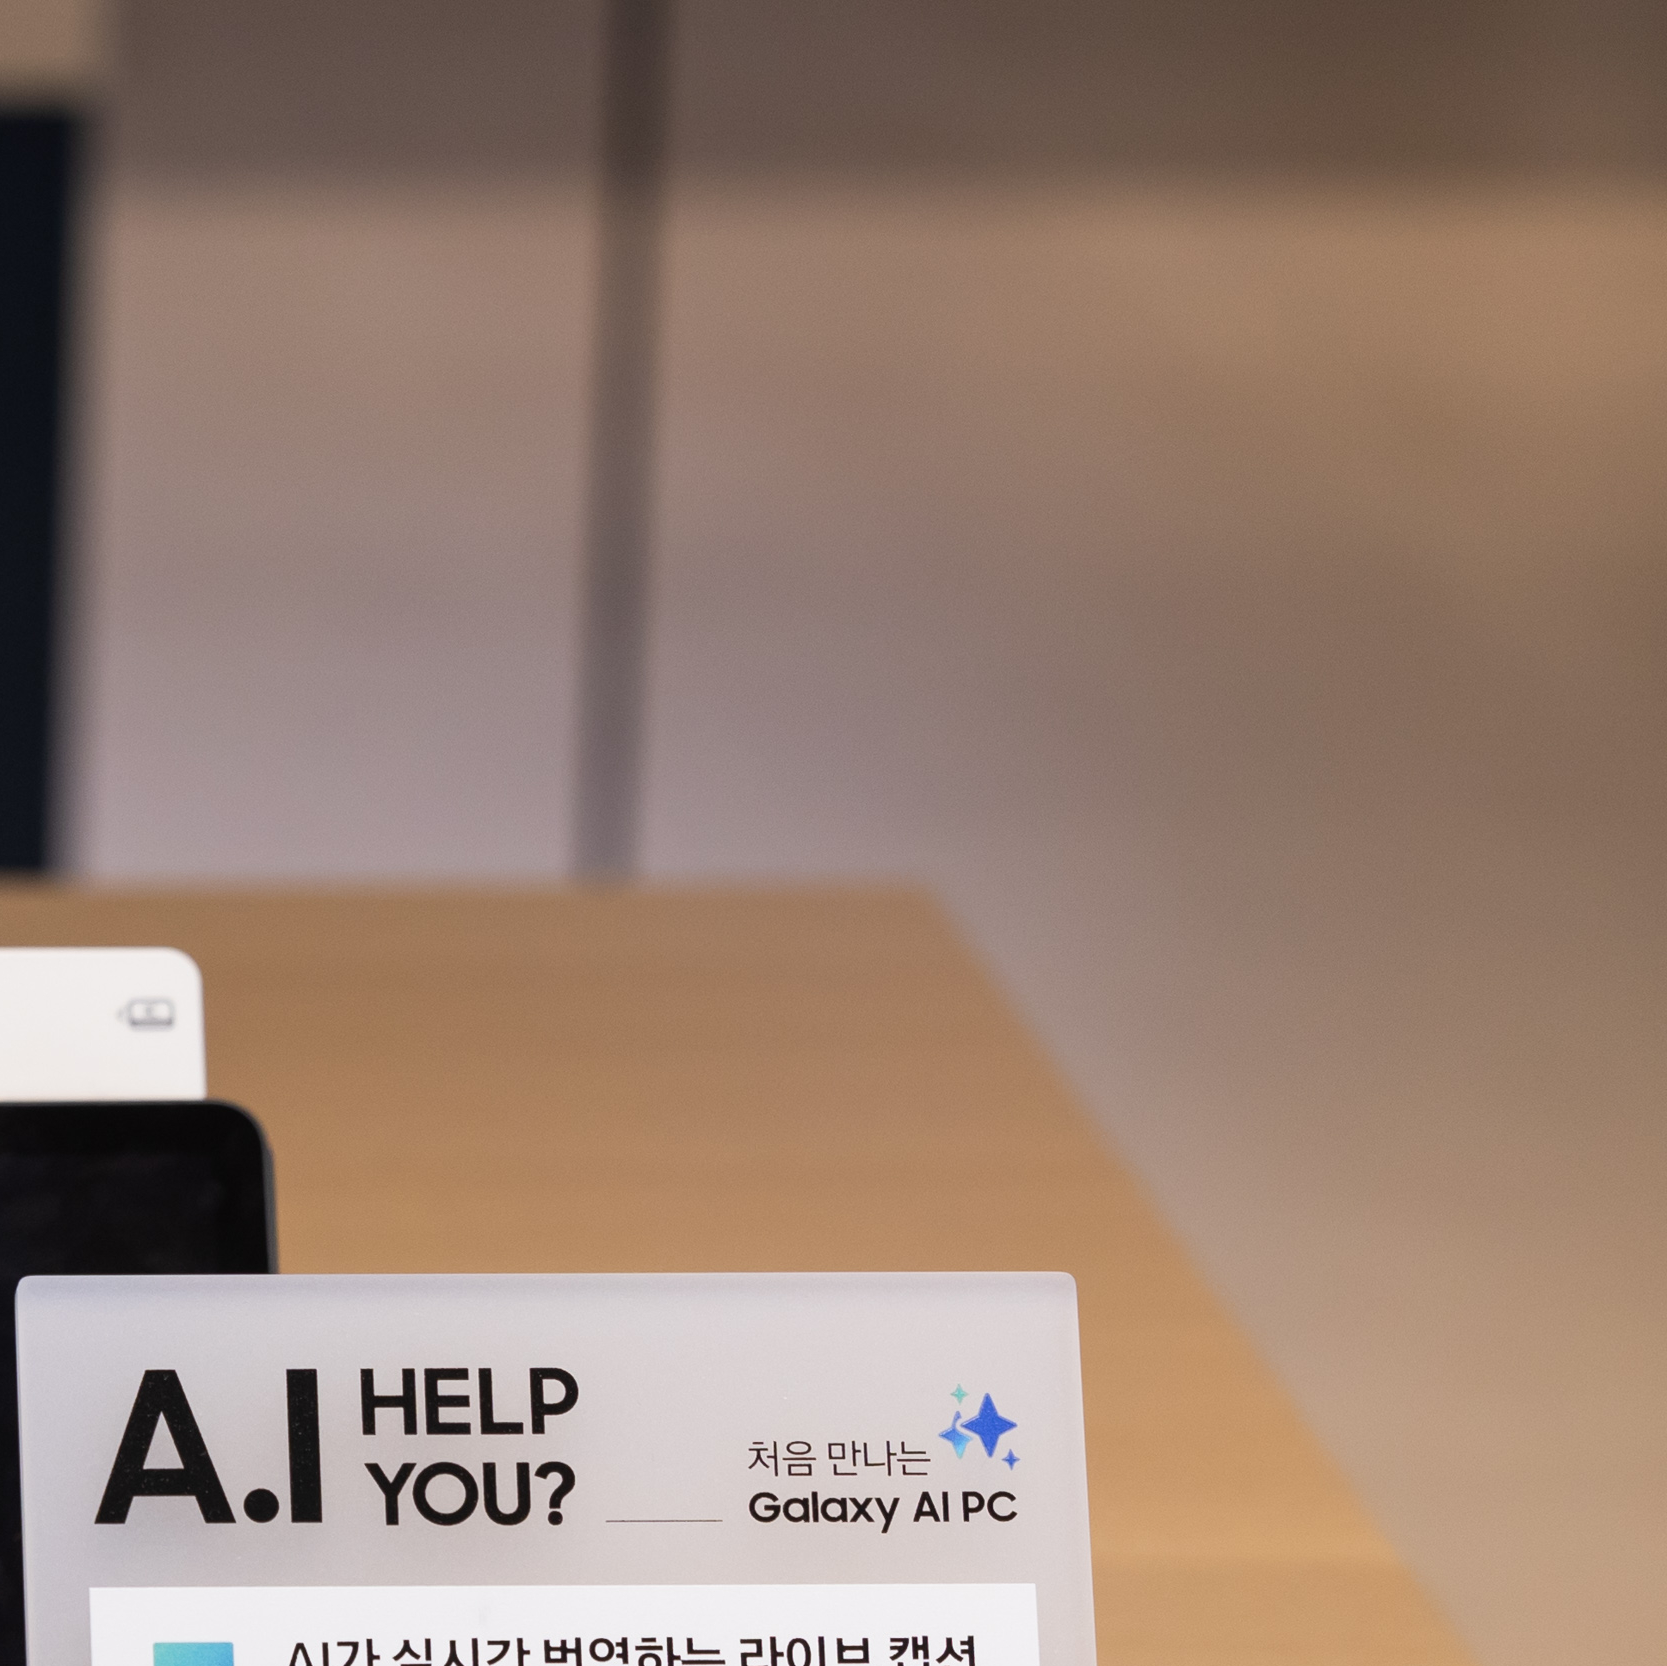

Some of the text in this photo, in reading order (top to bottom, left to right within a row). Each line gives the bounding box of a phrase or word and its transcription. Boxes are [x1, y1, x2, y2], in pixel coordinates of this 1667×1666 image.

[361, 1368, 578, 1436] HELP
[95, 1369, 322, 1525] A.I
[749, 1440, 930, 1477] 처음 만나는
[365, 1461, 575, 1526] YOU?
[749, 1491, 1017, 1533] Galaxy AI PC
